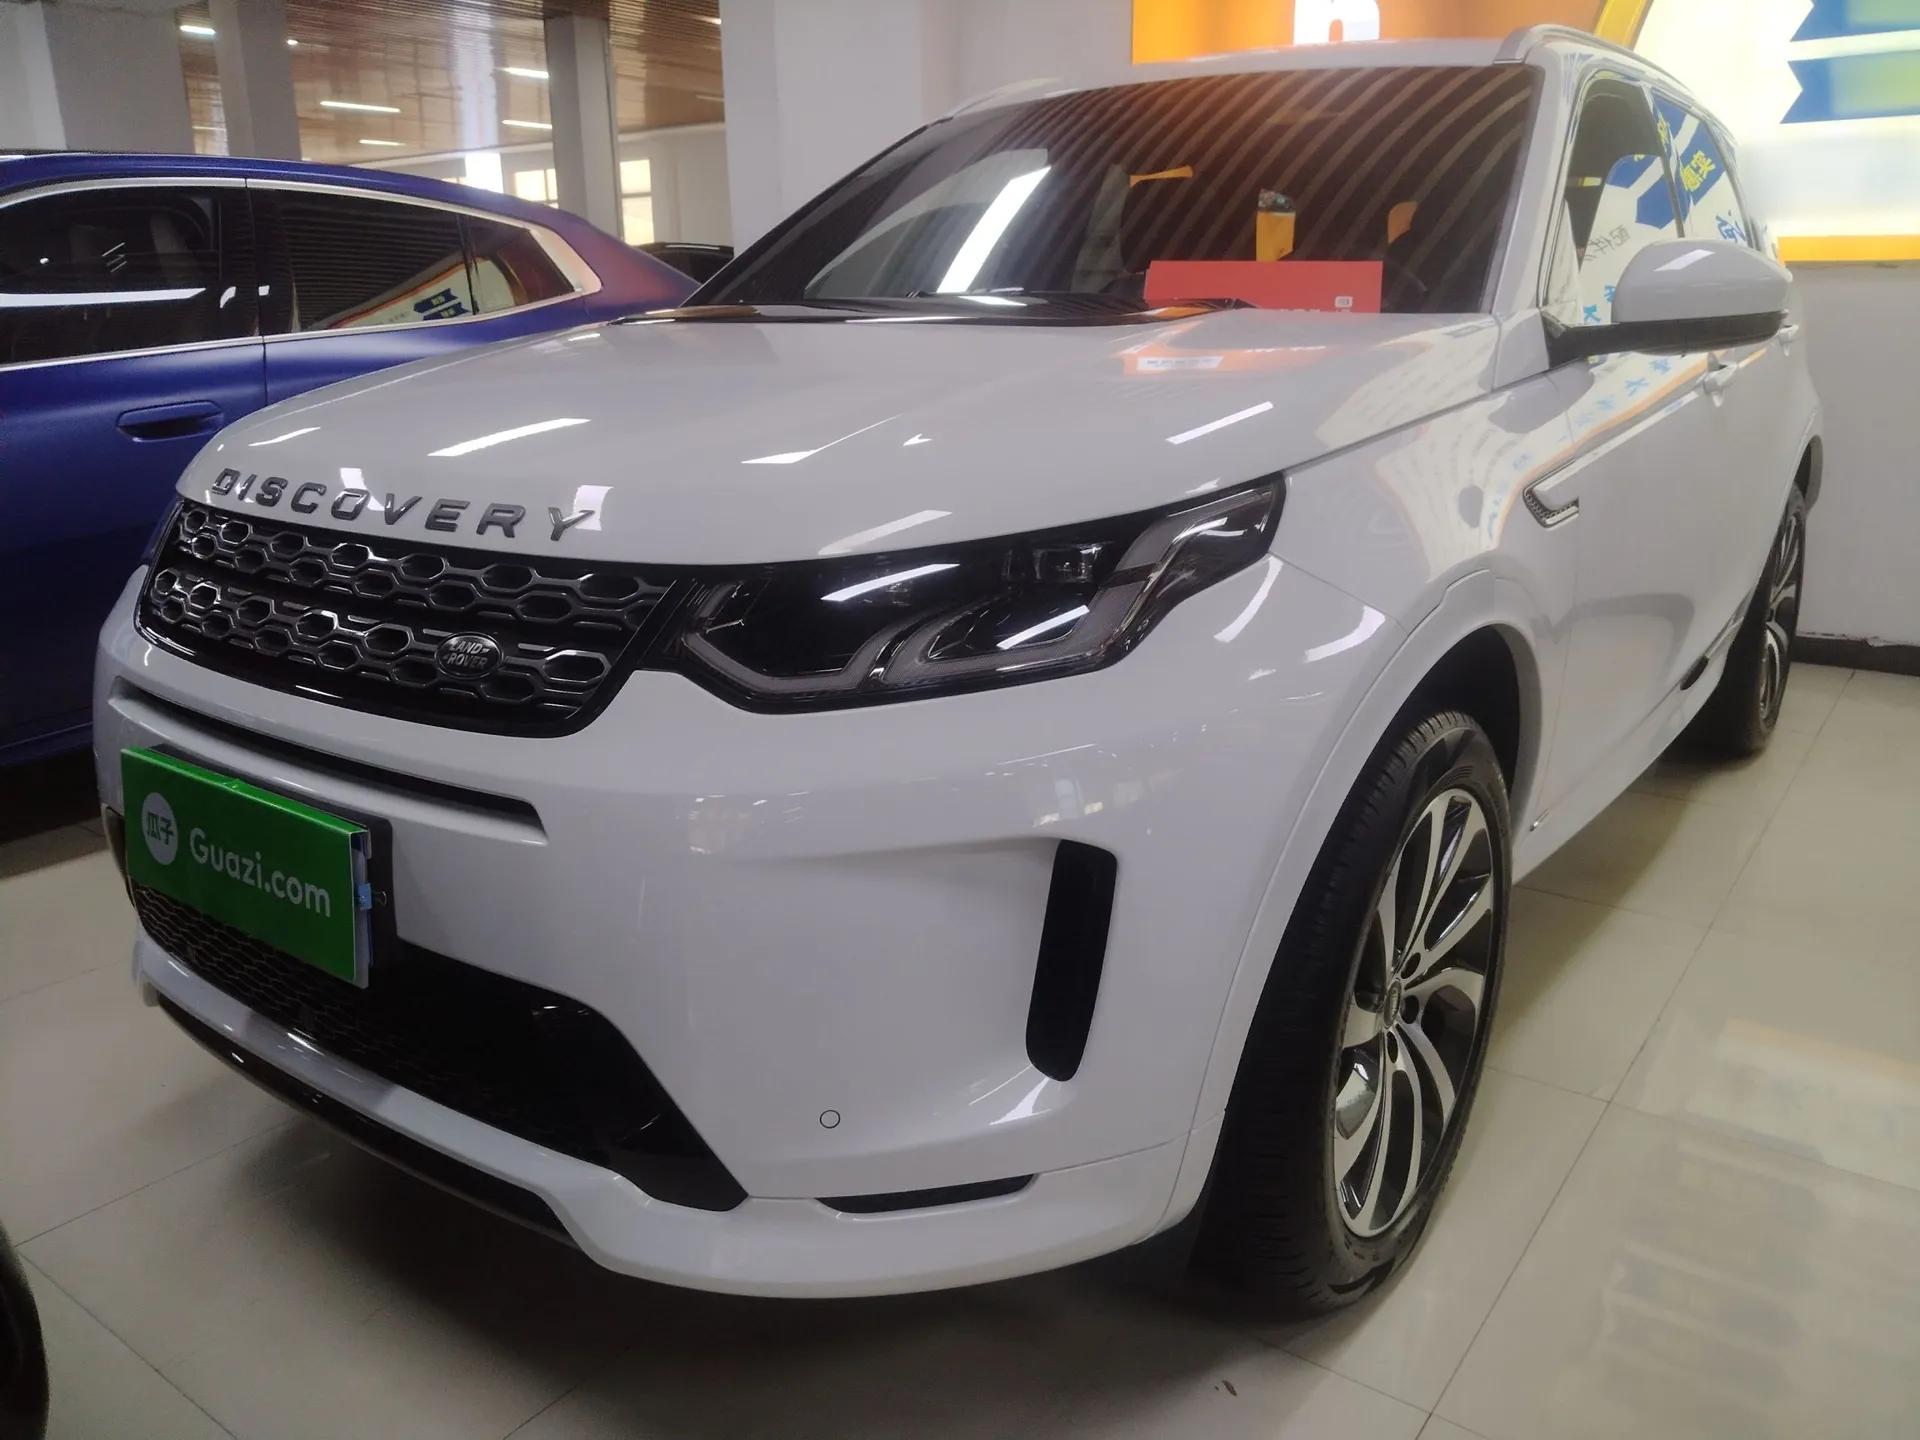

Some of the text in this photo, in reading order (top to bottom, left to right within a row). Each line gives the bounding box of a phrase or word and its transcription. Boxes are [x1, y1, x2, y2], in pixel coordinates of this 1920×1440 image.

[211, 467, 597, 542] DISCOVERY
[446, 652, 489, 669] ROVER
[448, 640, 484, 655] LAND
[146, 812, 174, 845] 瓜子
[189, 827, 331, 918] Guazi.com
